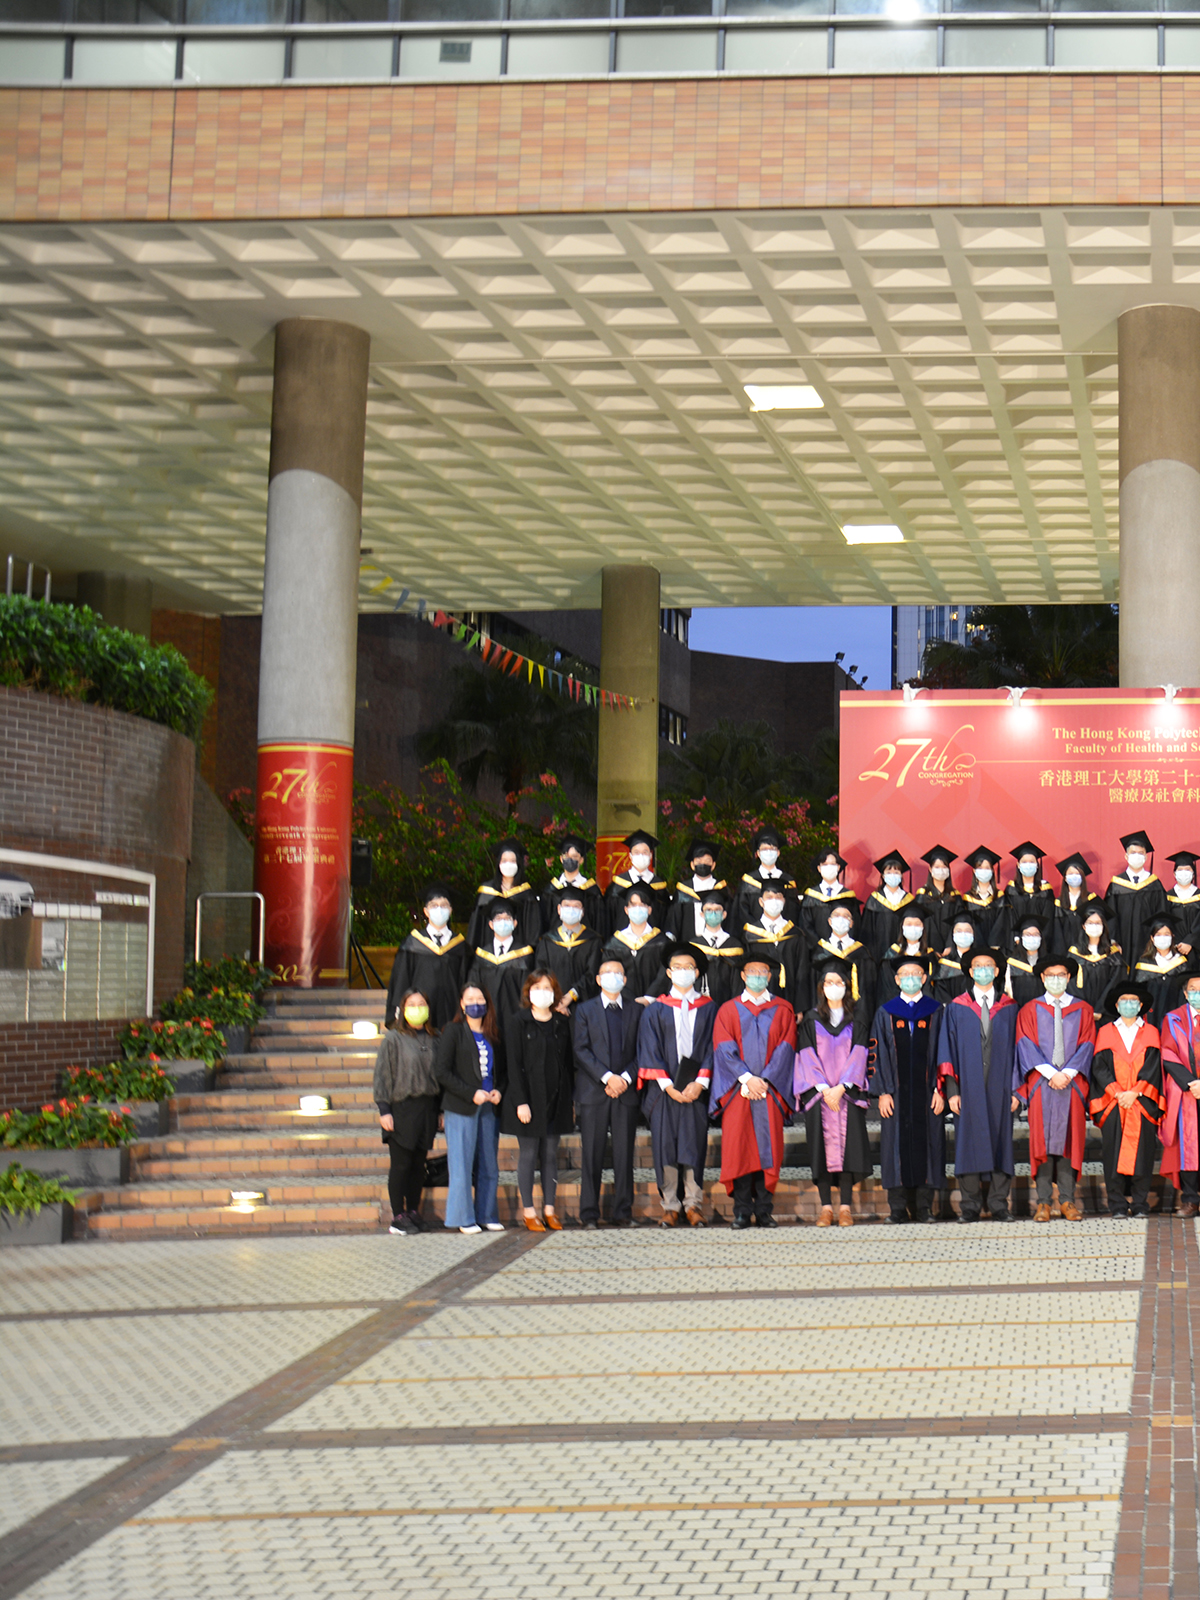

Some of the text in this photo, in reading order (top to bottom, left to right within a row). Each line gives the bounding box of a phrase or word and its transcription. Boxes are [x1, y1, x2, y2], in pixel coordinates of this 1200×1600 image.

[1052, 727, 1077, 739] The
[1080, 727, 1114, 742] Hong
[1117, 727, 1151, 741] Kong
[1065, 743, 1107, 756] Faculty
[1110, 743, 1123, 753] of
[1126, 742, 1163, 753] Health
[1166, 742, 1187, 752] and
[858, 724, 977, 788] 27th
[261, 761, 338, 804] 27th
